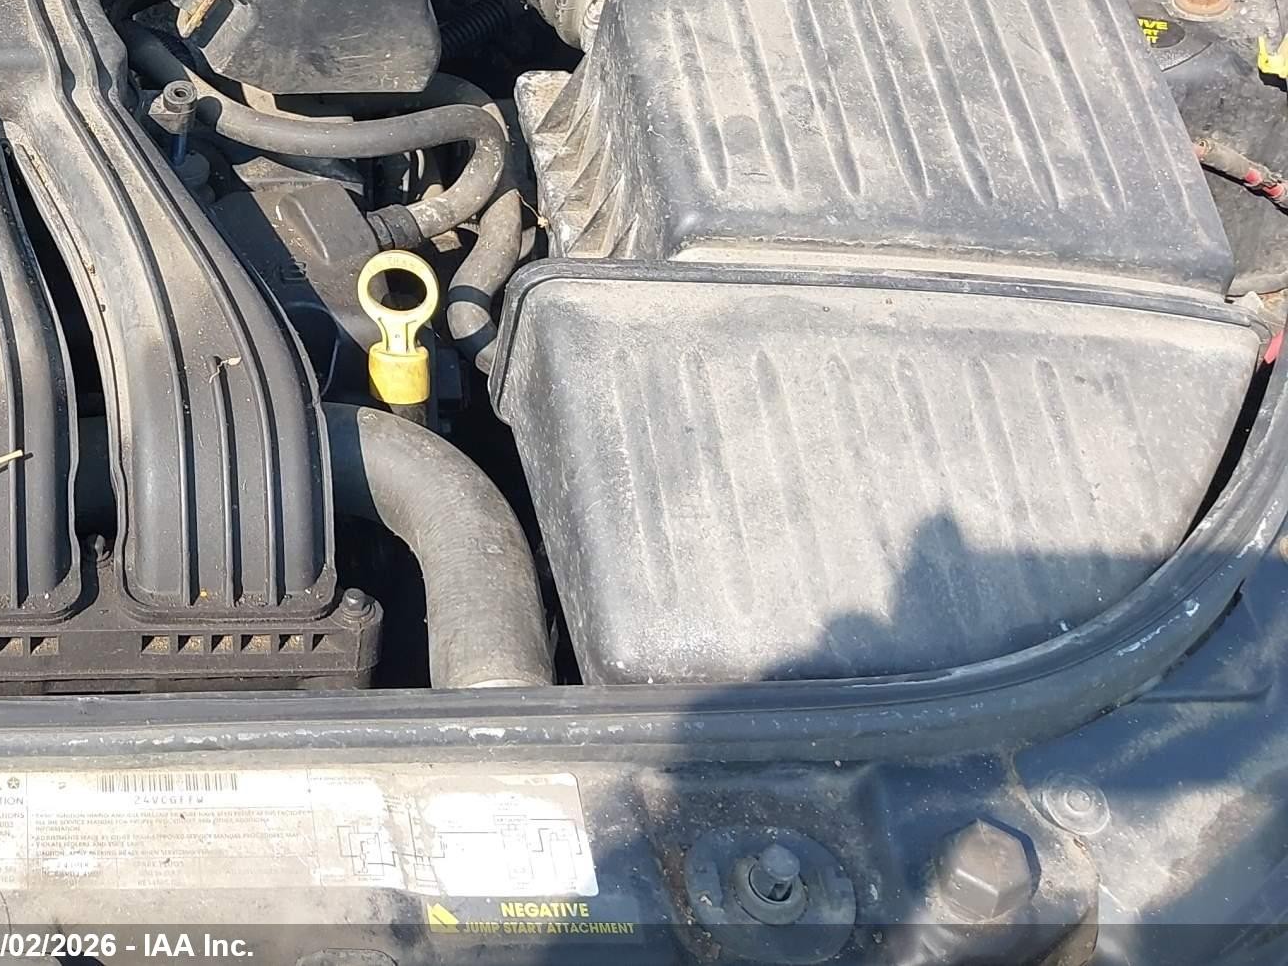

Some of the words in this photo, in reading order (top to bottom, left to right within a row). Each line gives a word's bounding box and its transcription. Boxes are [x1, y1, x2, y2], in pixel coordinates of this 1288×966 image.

[500, 901, 590, 918] NEGATIVE
[463, 922, 500, 934] JUMP
[502, 922, 545, 934] START
[548, 922, 635, 934] ATTACHMENT
